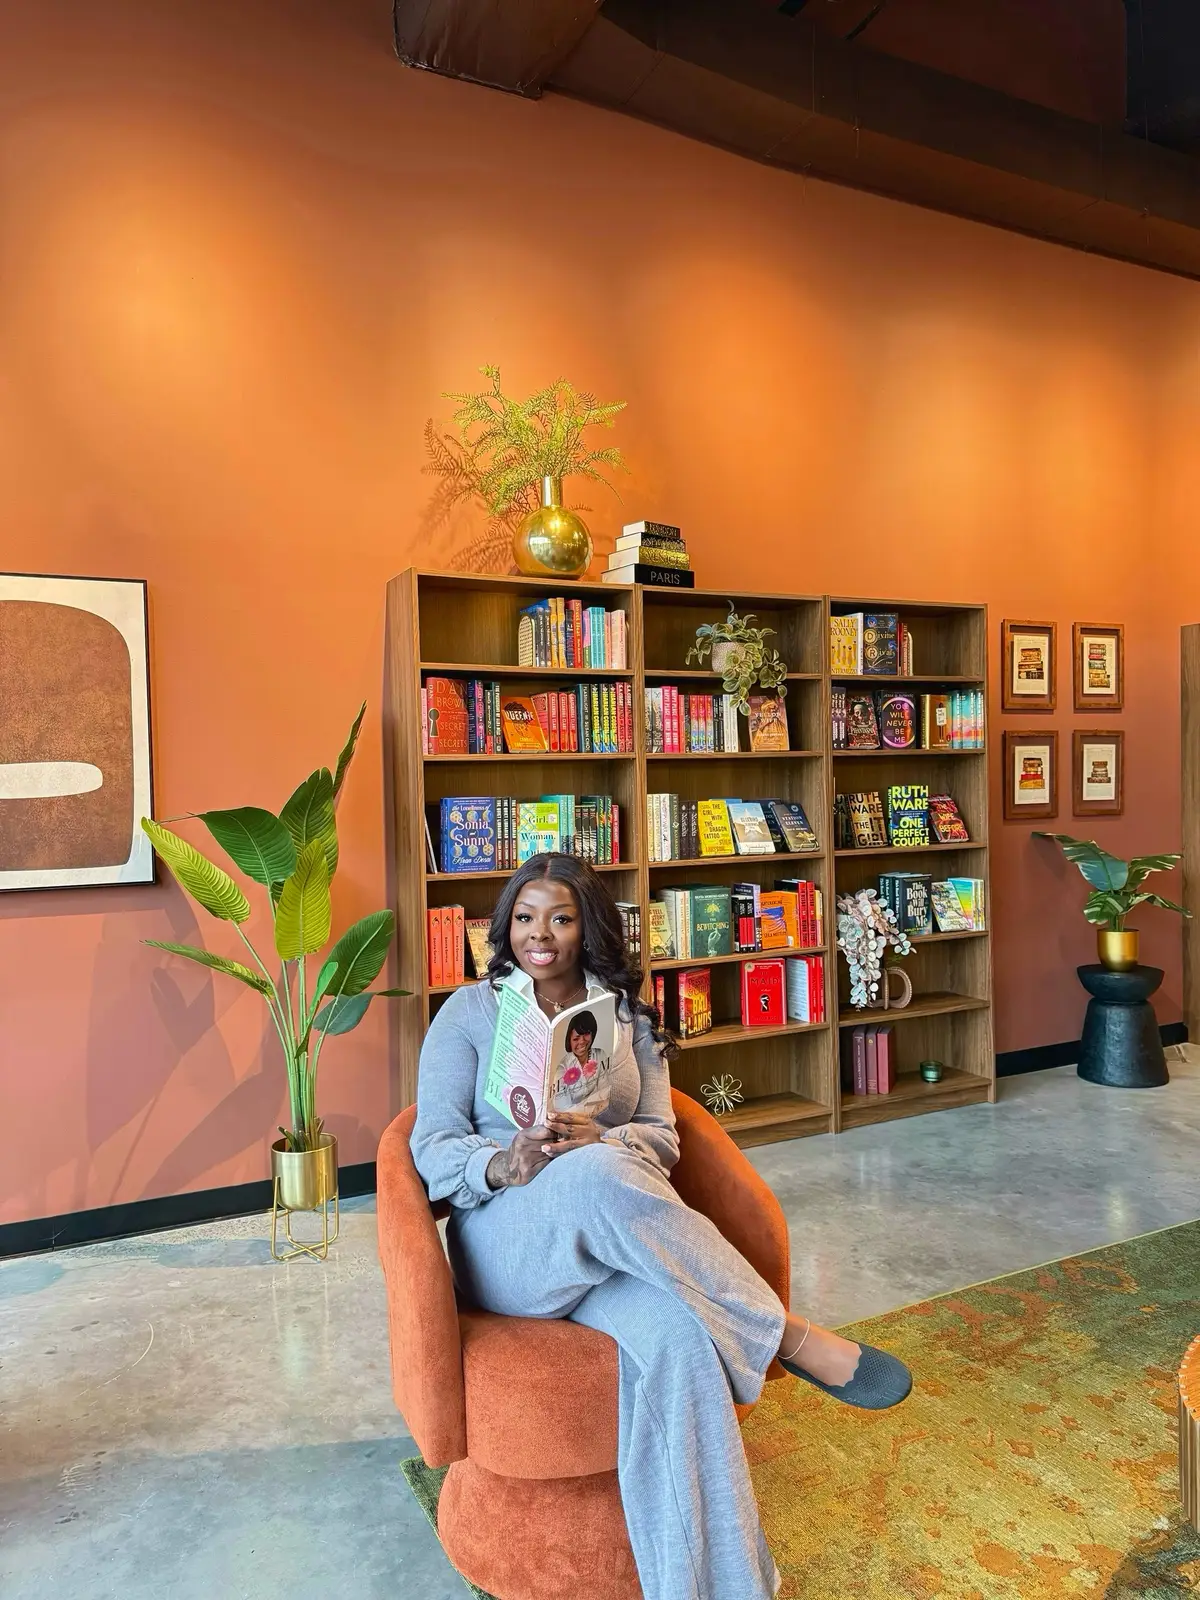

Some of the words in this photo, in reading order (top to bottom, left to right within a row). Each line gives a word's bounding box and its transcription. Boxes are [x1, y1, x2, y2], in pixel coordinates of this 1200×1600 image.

[650, 571, 680, 585] PARIS
[834, 618, 856, 628] SALLY
[866, 631, 895, 641] Divine
[440, 722, 466, 731] SECRET
[439, 739, 467, 747] SECRETS
[892, 785, 928, 798] RUTH
[848, 792, 881, 804] RUTH
[850, 803, 884, 814] WARE
[892, 798, 929, 811] WARE
[456, 818, 489, 830] Sonia
[854, 821, 869, 829] THE
[869, 817, 884, 832] IT
[899, 816, 924, 829] ONE
[893, 828, 929, 837] PERFECT
[454, 834, 490, 847] Sunny
[892, 837, 930, 847] COUPLE
[912, 882, 923, 890] This
[906, 886, 928, 900] Book
[912, 898, 925, 907] Will
[907, 905, 928, 917] Bury
[696, 922, 729, 931] BEWITCHING
[915, 916, 928, 928] Me
[750, 977, 779, 985] MAID
[692, 992, 708, 1014] BAD
[688, 1011, 712, 1035] LANDS
